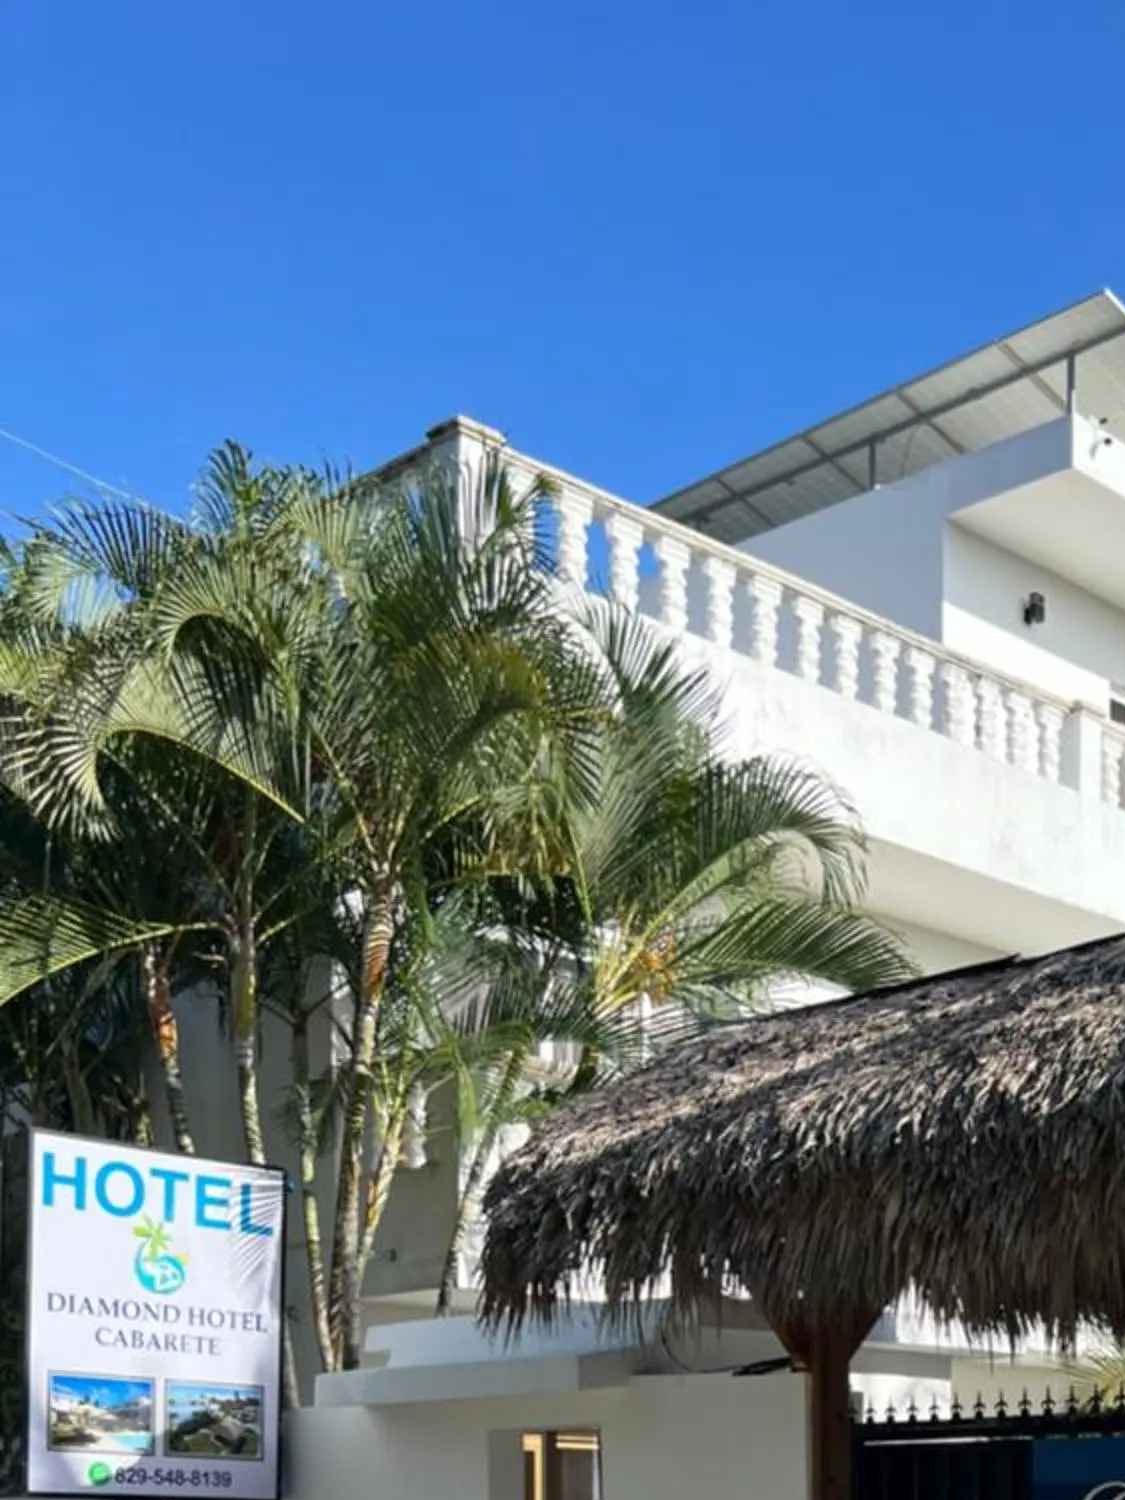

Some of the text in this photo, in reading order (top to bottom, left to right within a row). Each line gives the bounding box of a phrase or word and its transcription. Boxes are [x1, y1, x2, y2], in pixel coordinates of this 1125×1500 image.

[41, 1151, 273, 1237] HOTEL
[47, 1292, 268, 1333] DIAMOND HOTEL
[95, 1327, 221, 1356] CABARETE
[114, 1467, 232, 1488] 829-548-8139
